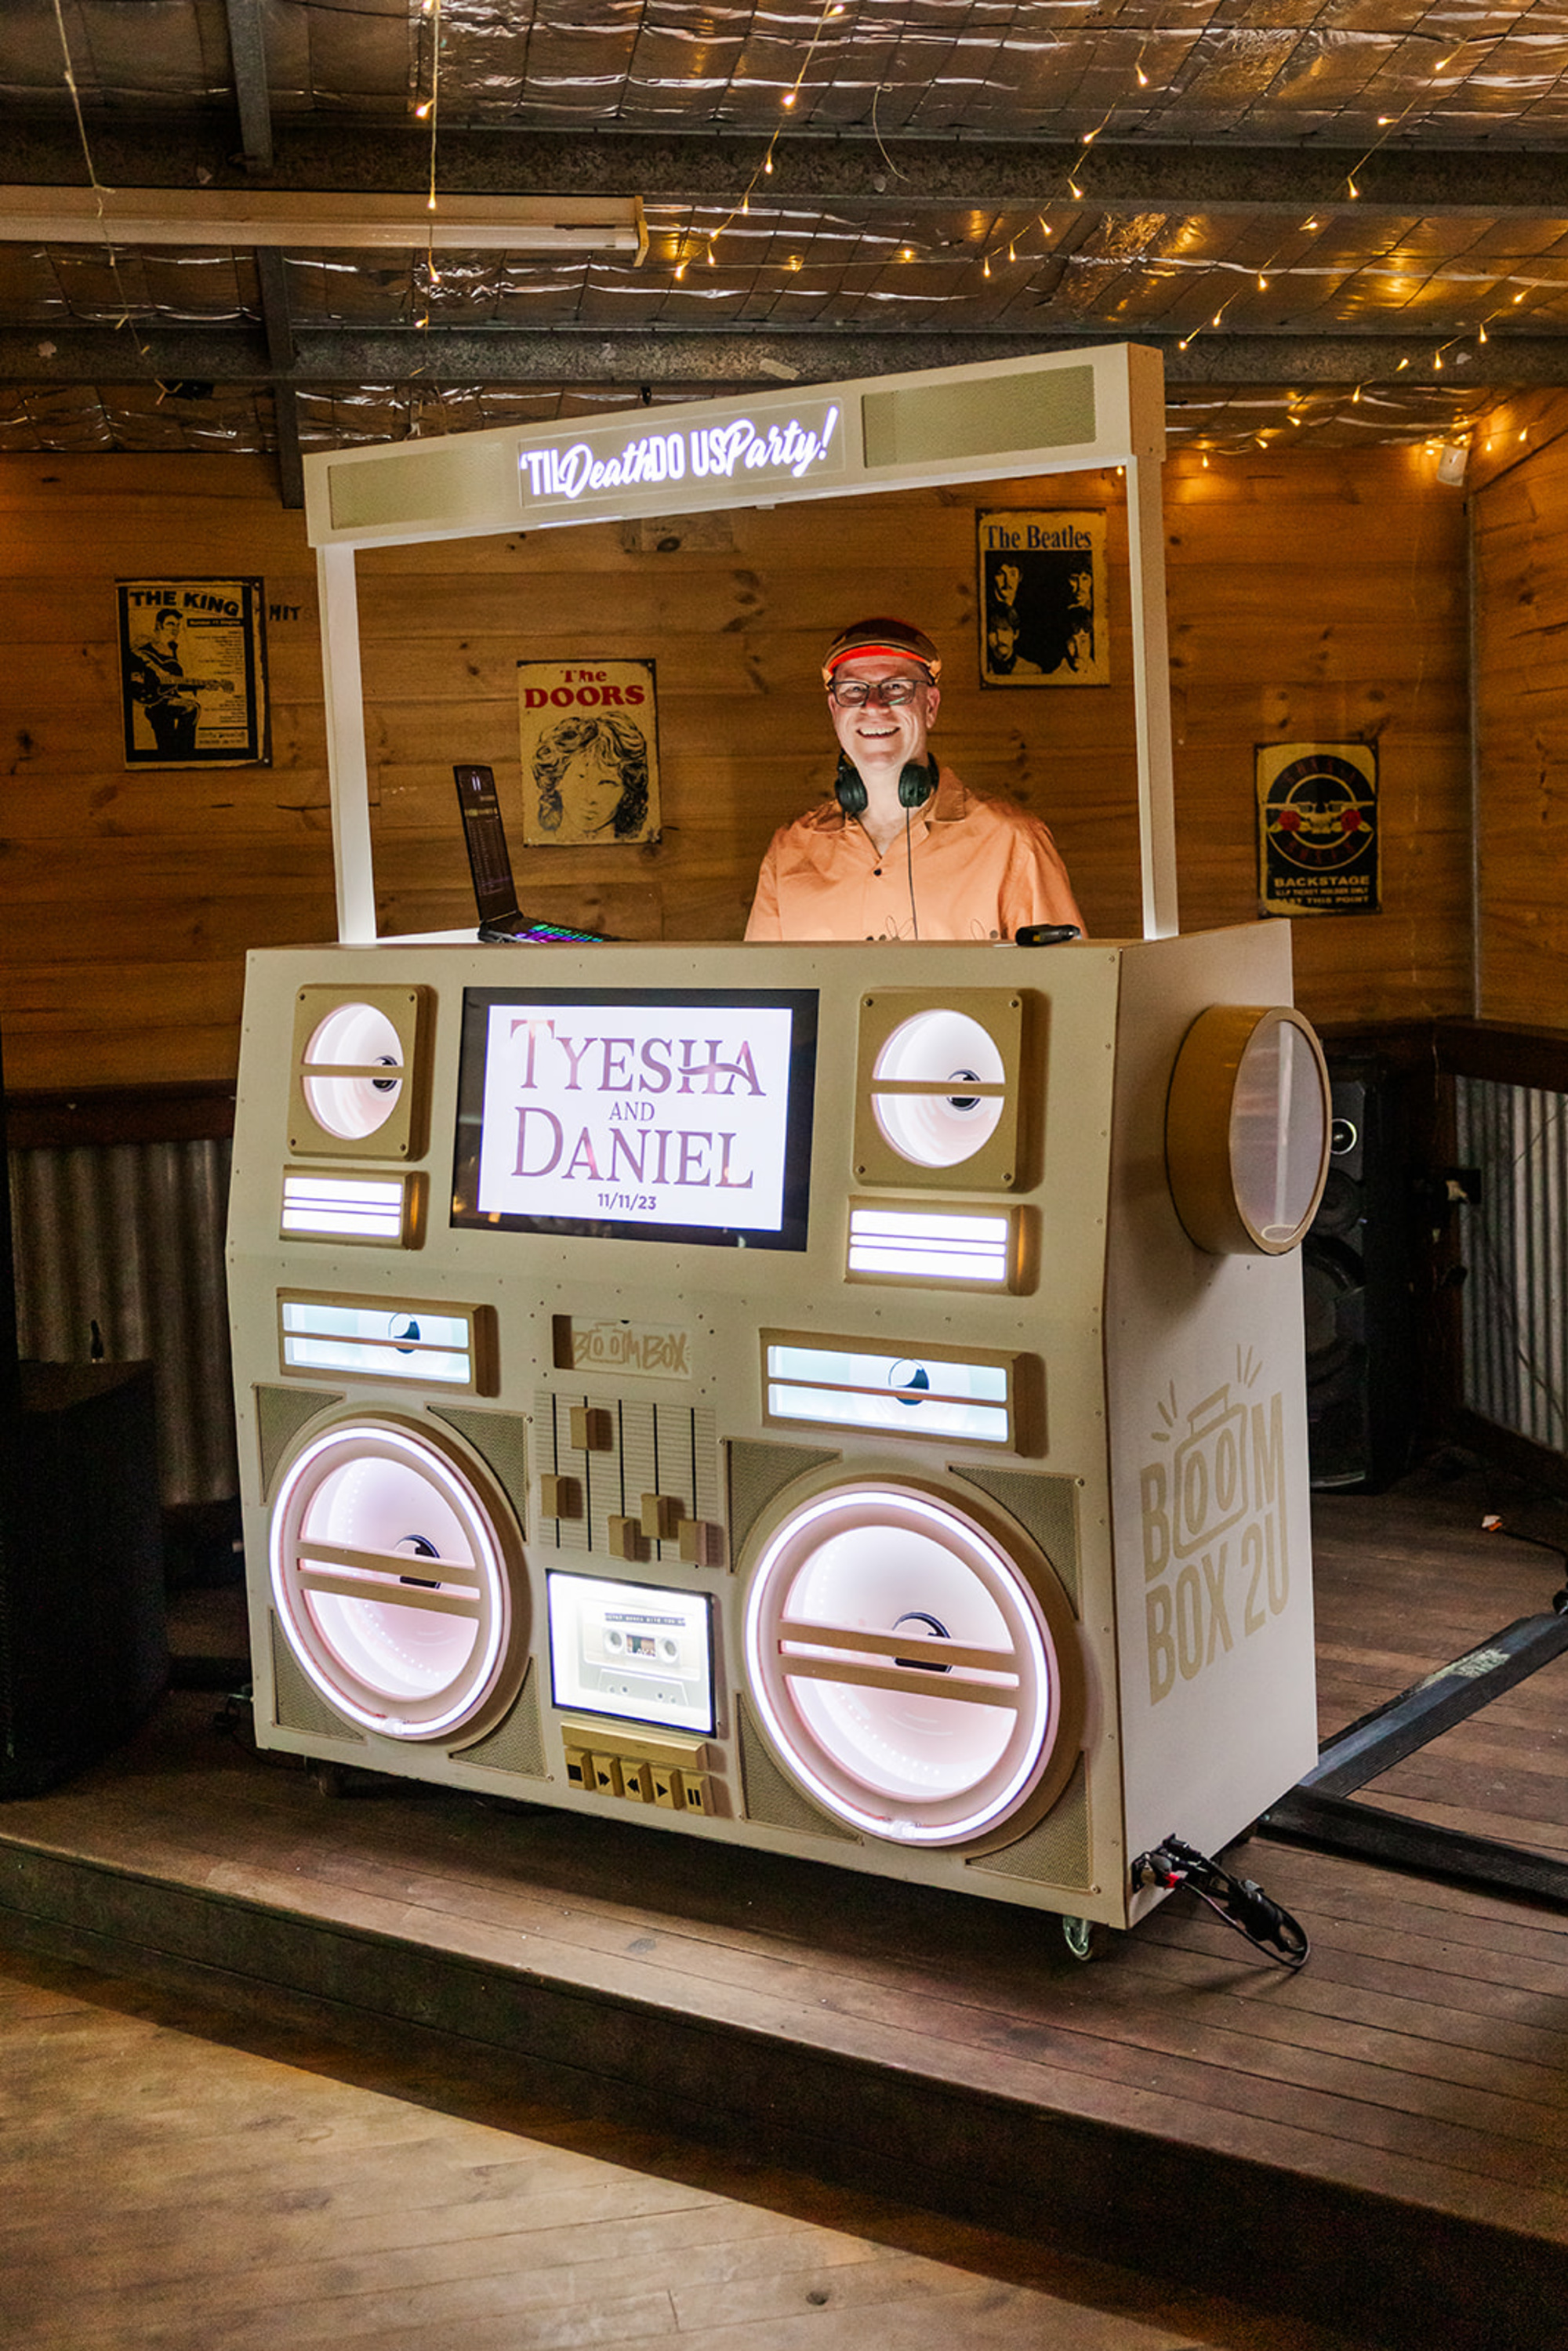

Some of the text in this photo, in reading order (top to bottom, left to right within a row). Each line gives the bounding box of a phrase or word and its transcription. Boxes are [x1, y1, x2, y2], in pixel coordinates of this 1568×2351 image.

[559, 437, 653, 499] Death
[648, 433, 685, 482] DO
[689, 428, 731, 477] US
[721, 405, 840, 478] Party!
[983, 524, 1091, 548] The Beatles
[129, 591, 239, 616] THE KING
[270, 604, 301, 621] HIT
[560, 669, 608, 682] The
[524, 684, 645, 708] DOORS
[1273, 875, 1370, 887] BACKSTAGE
[1334, 895, 1369, 904] POINT
[510, 1019, 766, 1096] TYESHA
[609, 1101, 655, 1121] AND
[510, 1106, 753, 1188] DANIEL
[597, 1192, 657, 1210] 11/11/23
[1141, 1391, 1284, 1584] BOOM
[1145, 1513, 1290, 1707] BOX 2U
